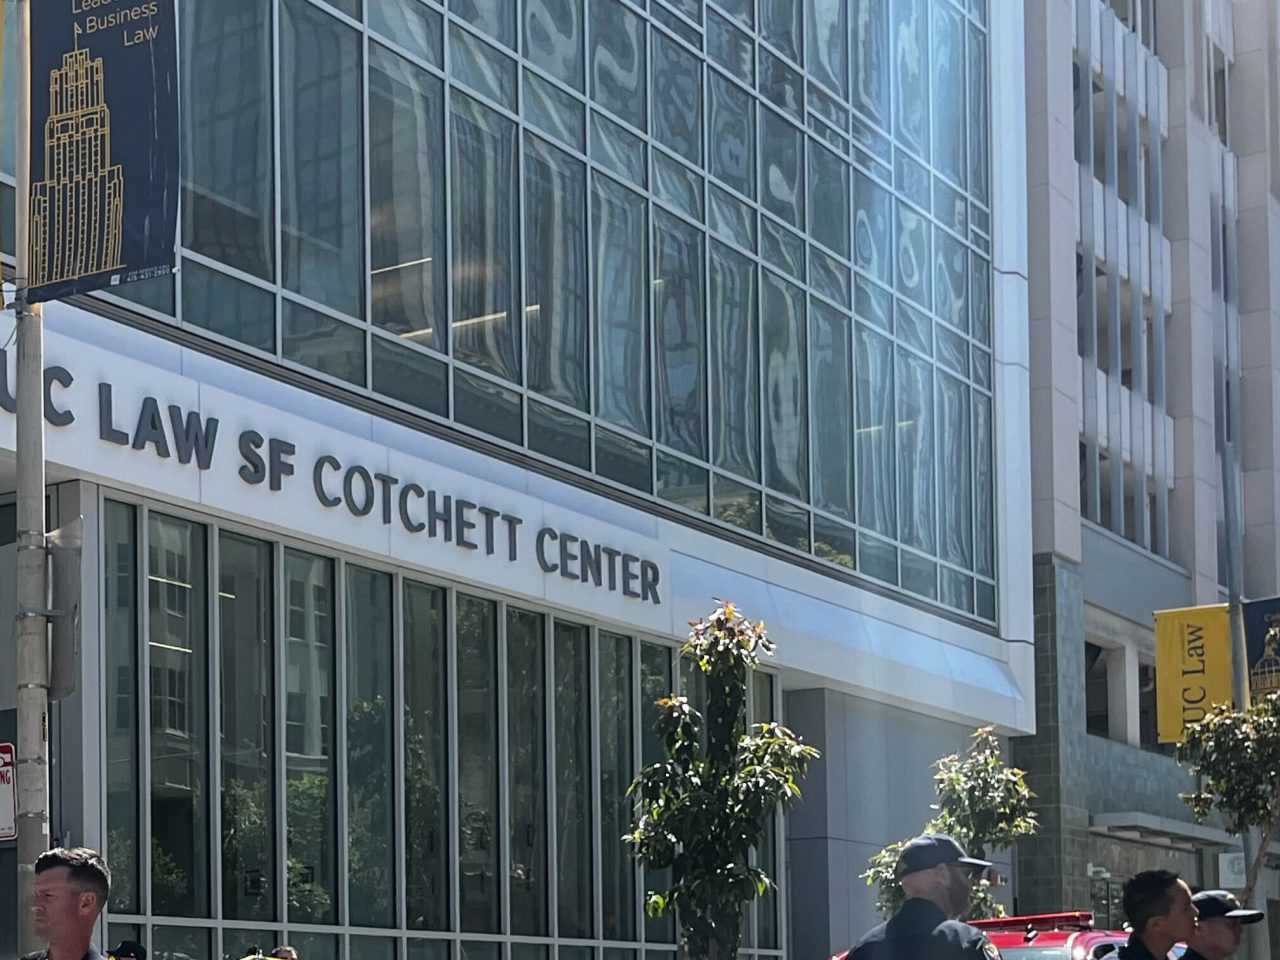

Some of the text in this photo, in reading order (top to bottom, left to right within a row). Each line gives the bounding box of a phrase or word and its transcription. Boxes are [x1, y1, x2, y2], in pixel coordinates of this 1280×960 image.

[86, 2, 158, 34] Business
[123, 25, 158, 46] Law
[99, 382, 218, 470] LAW
[238, 430, 296, 491] SF
[313, 455, 523, 562] COTCHETT
[536, 527, 662, 605] CENTER
[1182, 623, 1206, 733] UC Law
